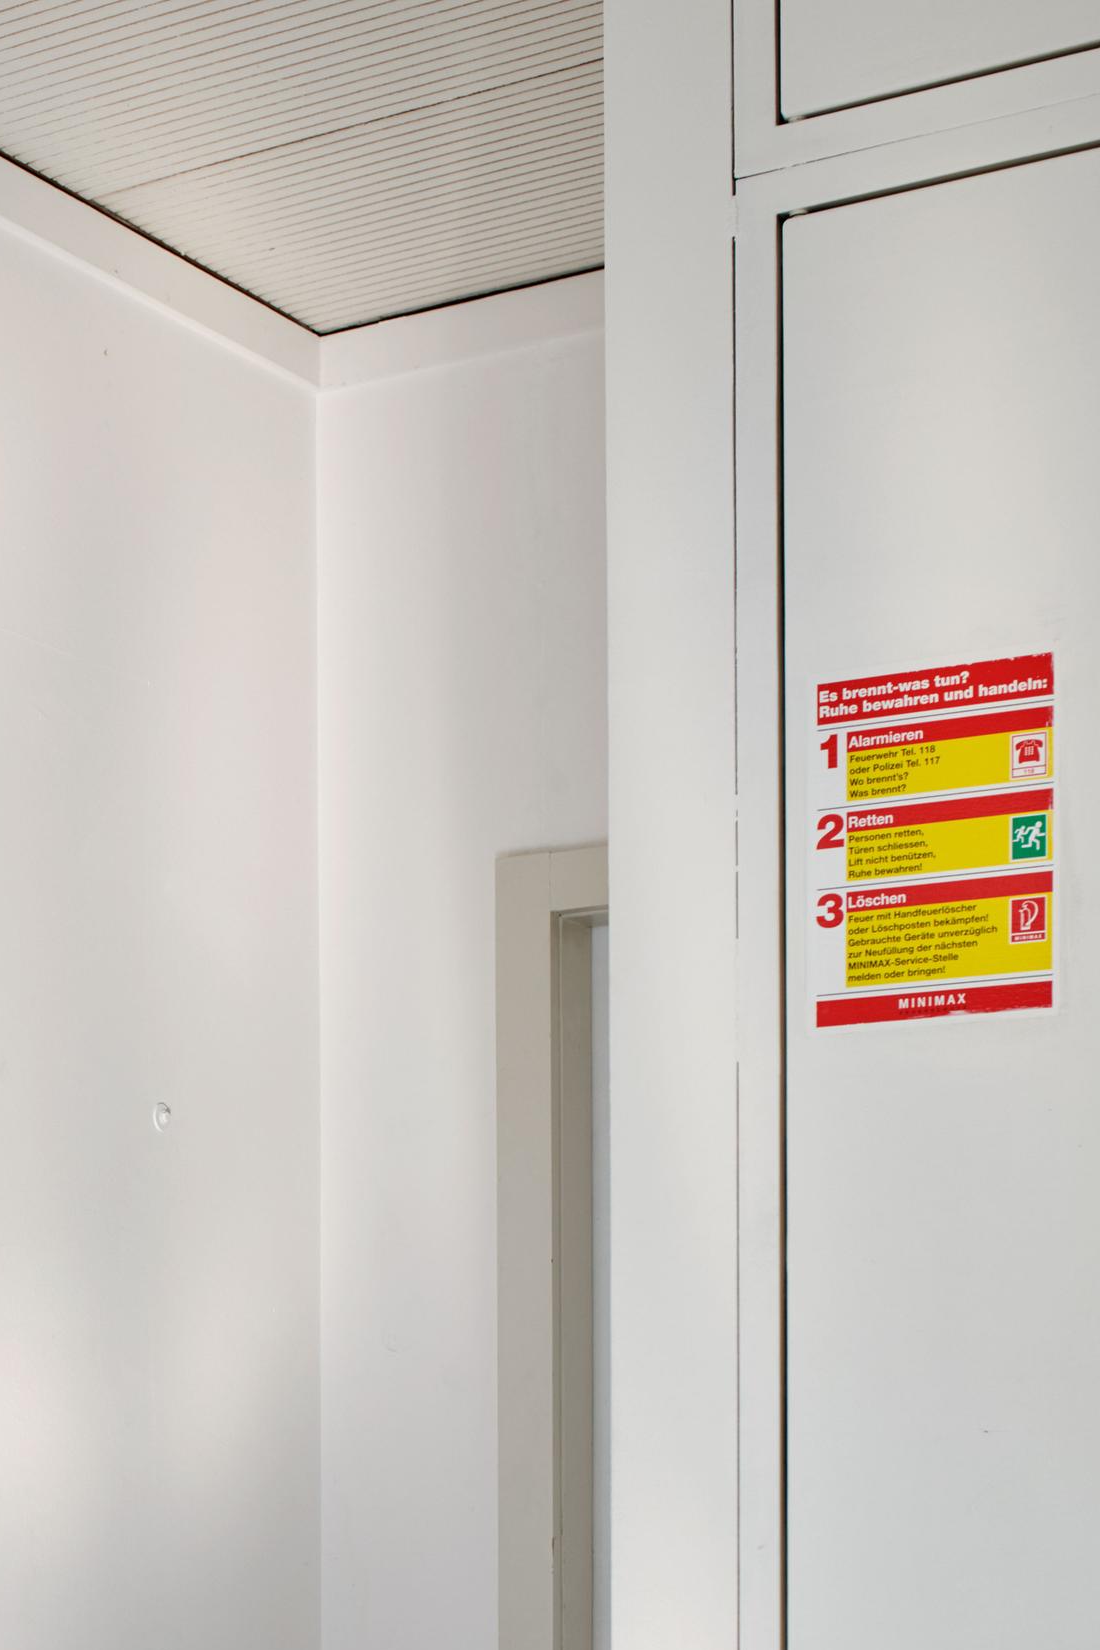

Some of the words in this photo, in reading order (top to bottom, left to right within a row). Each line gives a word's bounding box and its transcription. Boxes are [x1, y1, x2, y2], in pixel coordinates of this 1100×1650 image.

[819, 690, 838, 703] Es
[842, 679, 930, 700] brennt-was
[934, 671, 970, 687] tun?
[819, 703, 858, 718] Ruhe
[862, 693, 939, 712] bewahren
[944, 685, 974, 701] und
[978, 678, 1048, 697] handeln:
[849, 730, 924, 749] Alarmieren
[820, 733, 838, 769] 1
[849, 750, 898, 763] Feuerwehr
[901, 748, 916, 757] Tel.
[920, 745, 936, 754] 118
[849, 765, 870, 775] oder
[873, 762, 903, 772] Polizei
[906, 759, 921, 768] Tel.
[924, 756, 940, 766] 117
[849, 778, 864, 787] Wo
[867, 772, 909, 784] brennt's?
[849, 789, 869, 798] Was
[871, 784, 907, 795] brennt?
[848, 814, 894, 829] Retten
[816, 813, 844, 850] 2
[848, 832, 892, 843] Personen
[894, 829, 924, 838] retten,
[849, 846, 875, 855] Türen
[877, 840, 928, 852] schliessen,
[849, 858, 863, 867] Lift
[865, 855, 888, 865] nicht
[890, 851, 936, 862] benützen,
[848, 870, 872, 879] Ruhe
[874, 863, 922, 875] bewahren!
[848, 893, 907, 909] Löschen
[816, 893, 844, 929] 3
[848, 914, 874, 923] Feuer
[876, 912, 891, 920] mit
[893, 904, 977, 919] Handfeuerlöscher
[848, 926, 869, 935] oder
[871, 921, 931, 933] Löschposten
[933, 914, 989, 927] bekämpfen!
[848, 935, 901, 947] Gebrauchte
[904, 931, 936, 941] Geräte
[938, 925, 998, 938] unverzüglich
[848, 951, 862, 959] zur
[865, 946, 914, 957] Neufüllung
[916, 944, 932, 953] der
[934, 940, 978, 951] nächsten
[848, 953, 959, 970] MINIMAX-Service-Stelle
[848, 971, 881, 982] melden
[883, 970, 905, 979] oder
[907, 965, 946, 977] bringen!
[898, 993, 966, 1009] MINIMAX
